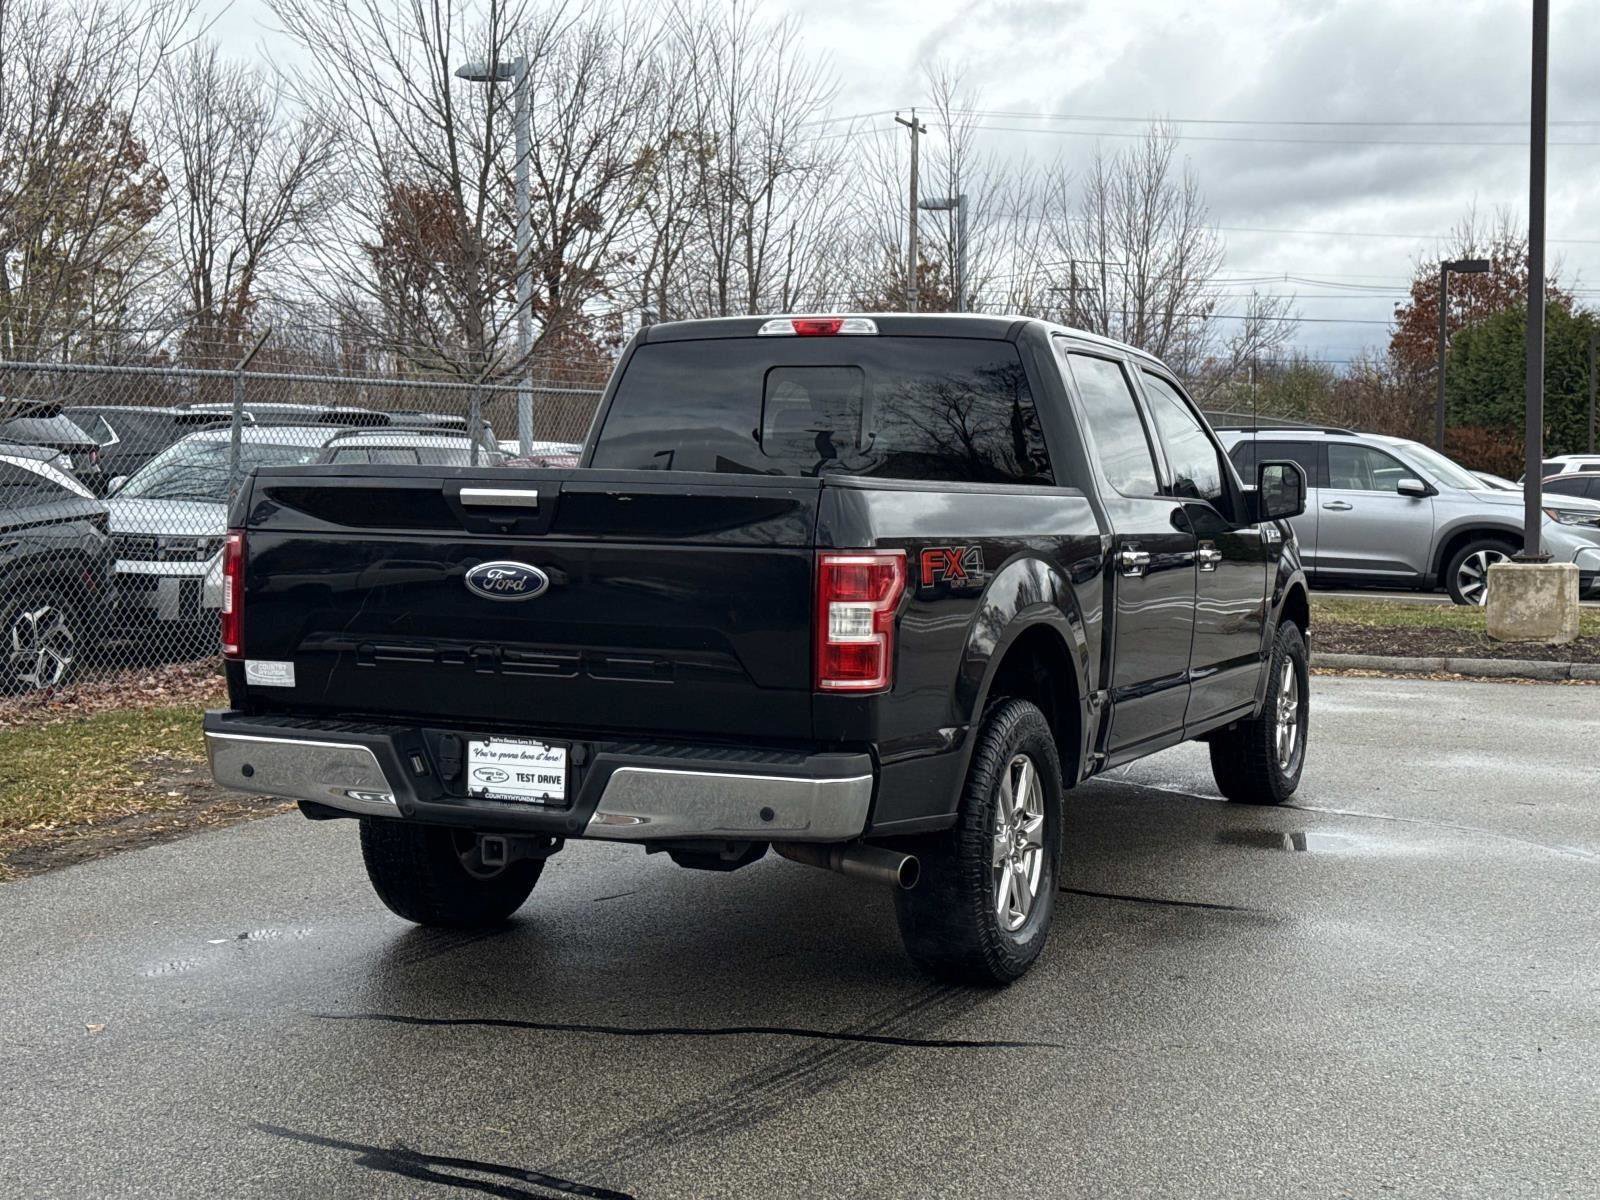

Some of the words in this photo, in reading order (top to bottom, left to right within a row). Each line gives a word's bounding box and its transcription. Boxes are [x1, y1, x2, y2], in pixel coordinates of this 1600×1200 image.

[920, 545, 985, 588] FX4
[482, 568, 528, 592] Ford
[258, 663, 287, 671] COUNTRY
[473, 747, 497, 757] You're
[498, 751, 519, 761] gonna
[520, 751, 535, 760] love
[544, 753, 563, 762] here!
[516, 772, 535, 783] TEST
[537, 774, 562, 785] DRIVE
